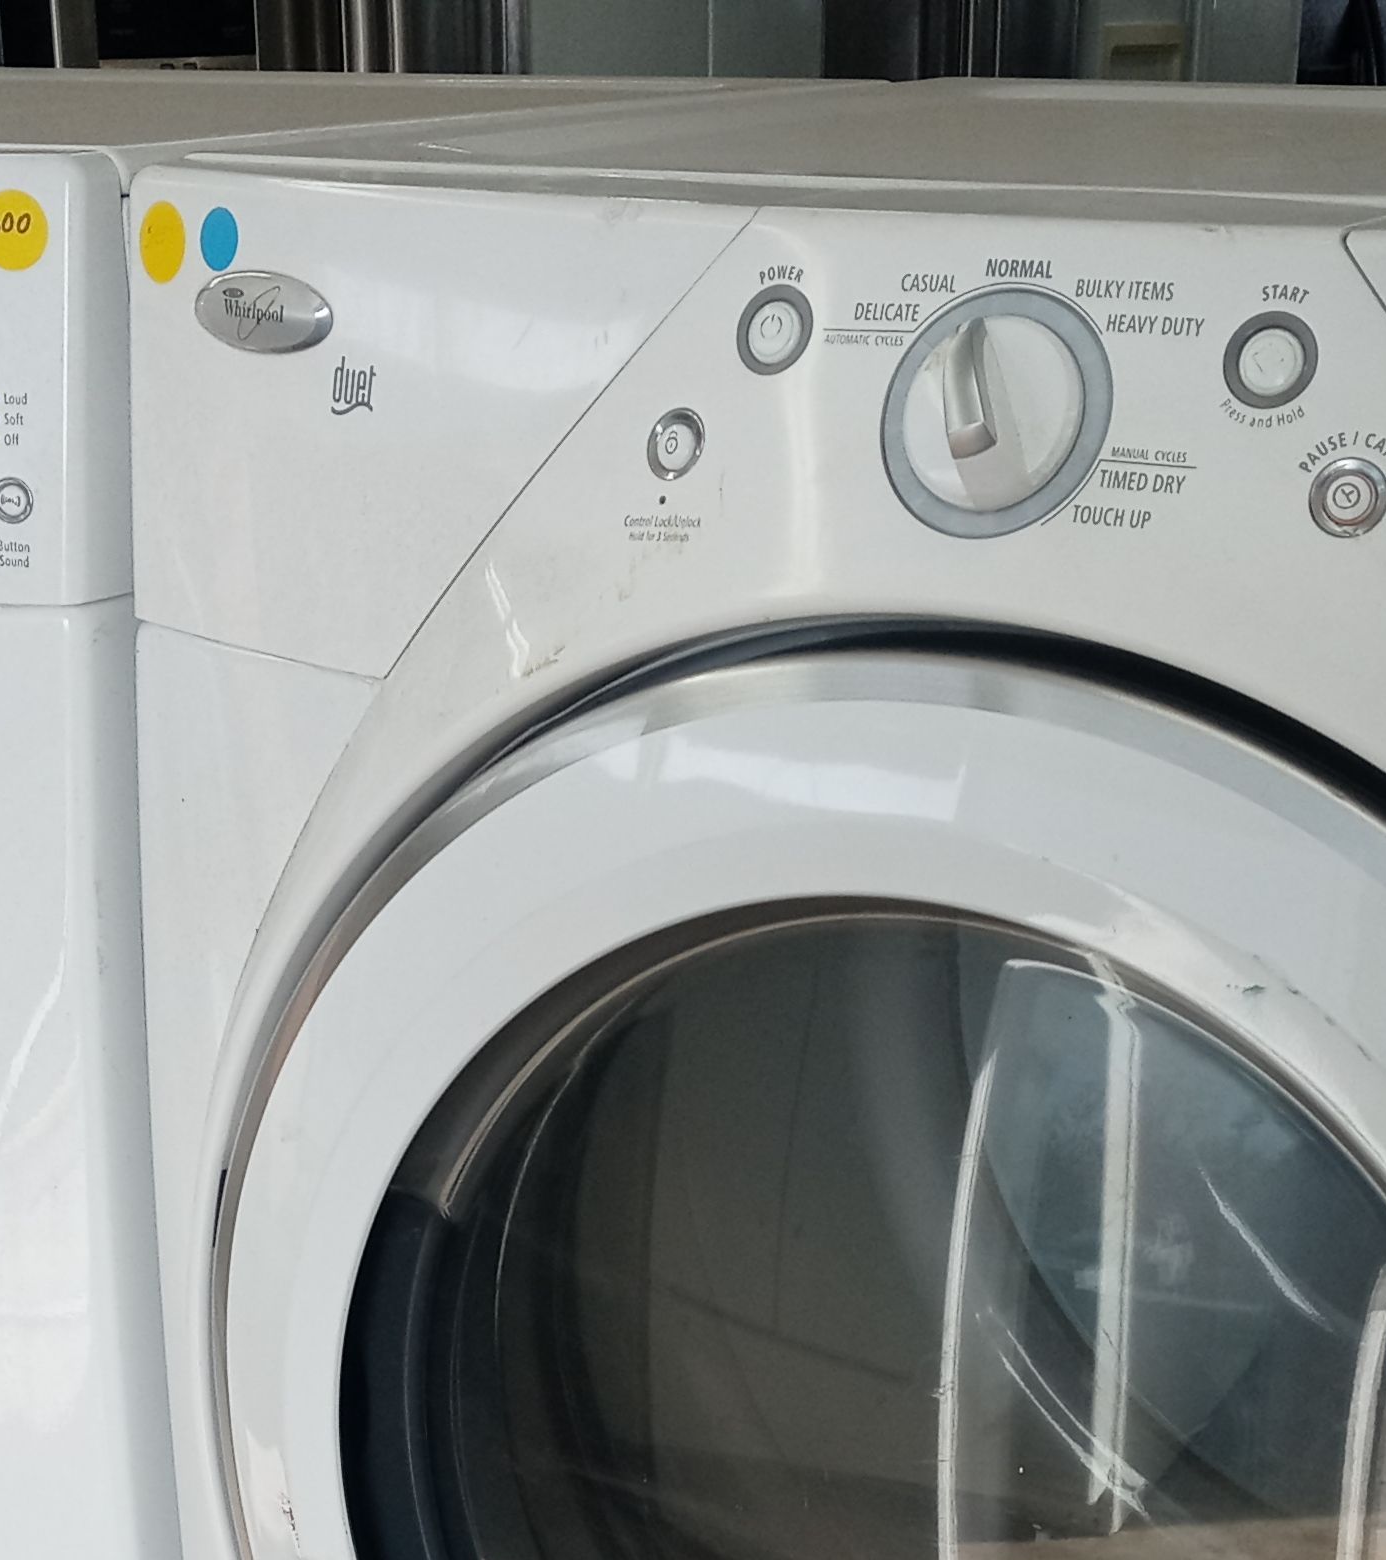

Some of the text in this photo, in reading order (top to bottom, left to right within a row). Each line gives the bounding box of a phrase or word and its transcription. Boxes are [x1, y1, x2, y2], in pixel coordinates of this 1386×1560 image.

[759, 264, 805, 285] POWER
[985, 258, 1053, 279] NORMAL
[901, 273, 956, 294] CASUAL
[1075, 278, 1175, 301] BULKY ITEMS
[1262, 284, 1310, 305] START
[223, 298, 284, 325] Whirlpool
[854, 302, 921, 323] DELICATE
[1105, 313, 1205, 337] HEAVY DUTY
[823, 333, 904, 347] AUTOMATIC CYCLES
[331, 355, 376, 410] duet
[4, 392, 28, 405] Loud
[4, 413, 24, 426] Soft
[1219, 398, 1305, 428] Press and Hold
[4, 434, 20, 447] Off
[1111, 446, 1188, 463] MANUAL CYCLES
[1298, 432, 1348, 474] PAUSE
[1351, 431, 1359, 446] /
[1099, 468, 1187, 495] TIMED DRY
[623, 514, 653, 527] Control
[1072, 504, 1152, 529] TOUCH UP
[0, 554, 29, 568] Sound
